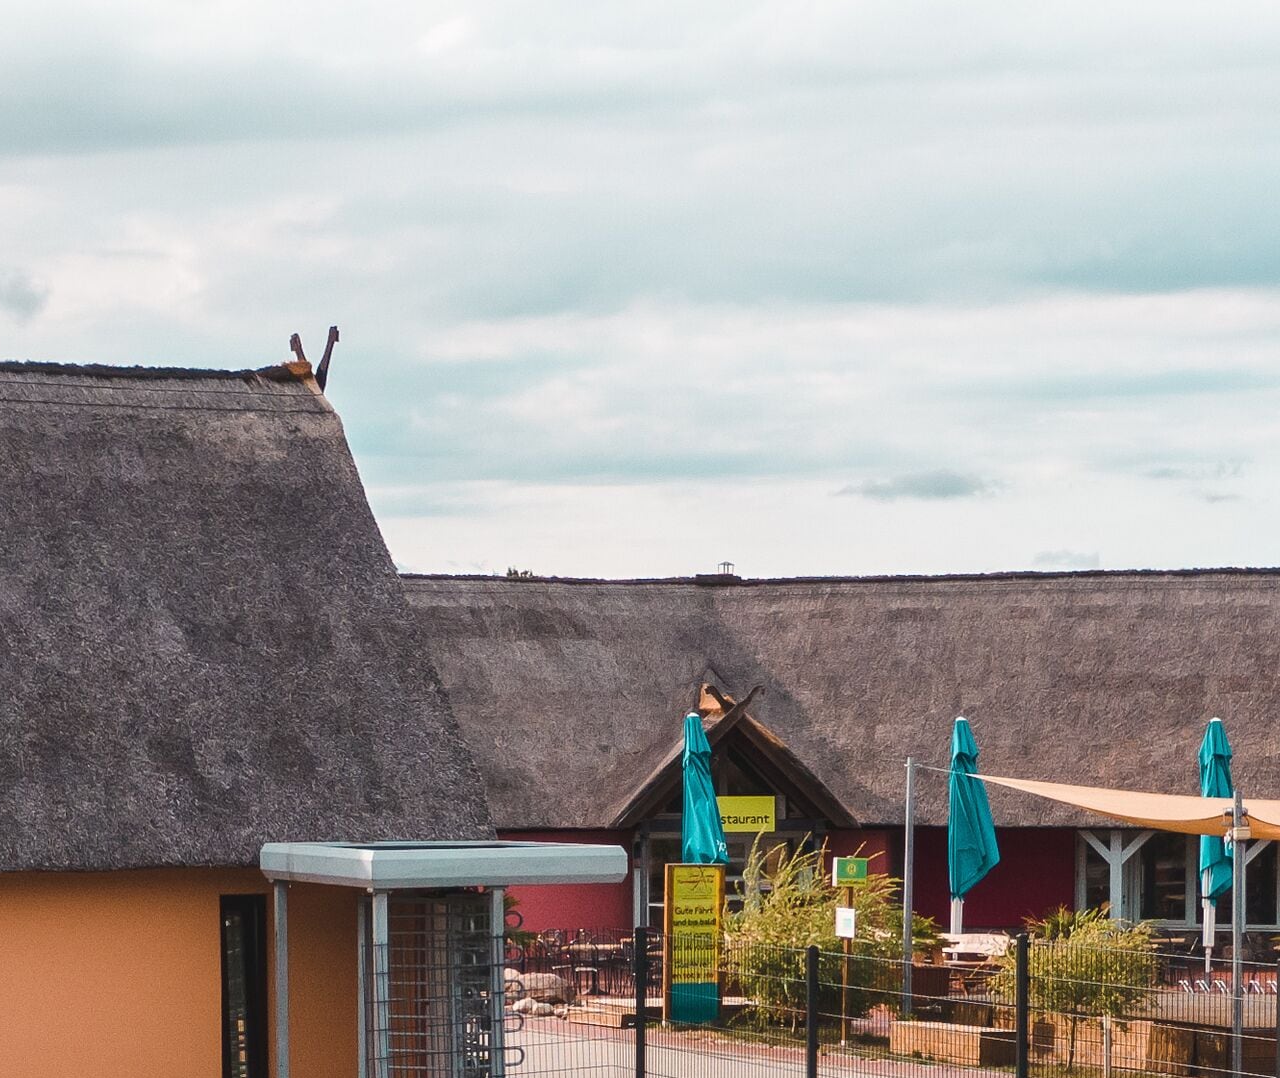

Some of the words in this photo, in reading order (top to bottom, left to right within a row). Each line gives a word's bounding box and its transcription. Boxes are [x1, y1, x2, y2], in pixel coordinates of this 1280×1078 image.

[720, 814, 770, 825] staurant
[675, 906, 694, 915] Gute
[694, 906, 713, 915] Fahrt
[673, 918, 687, 926] und
